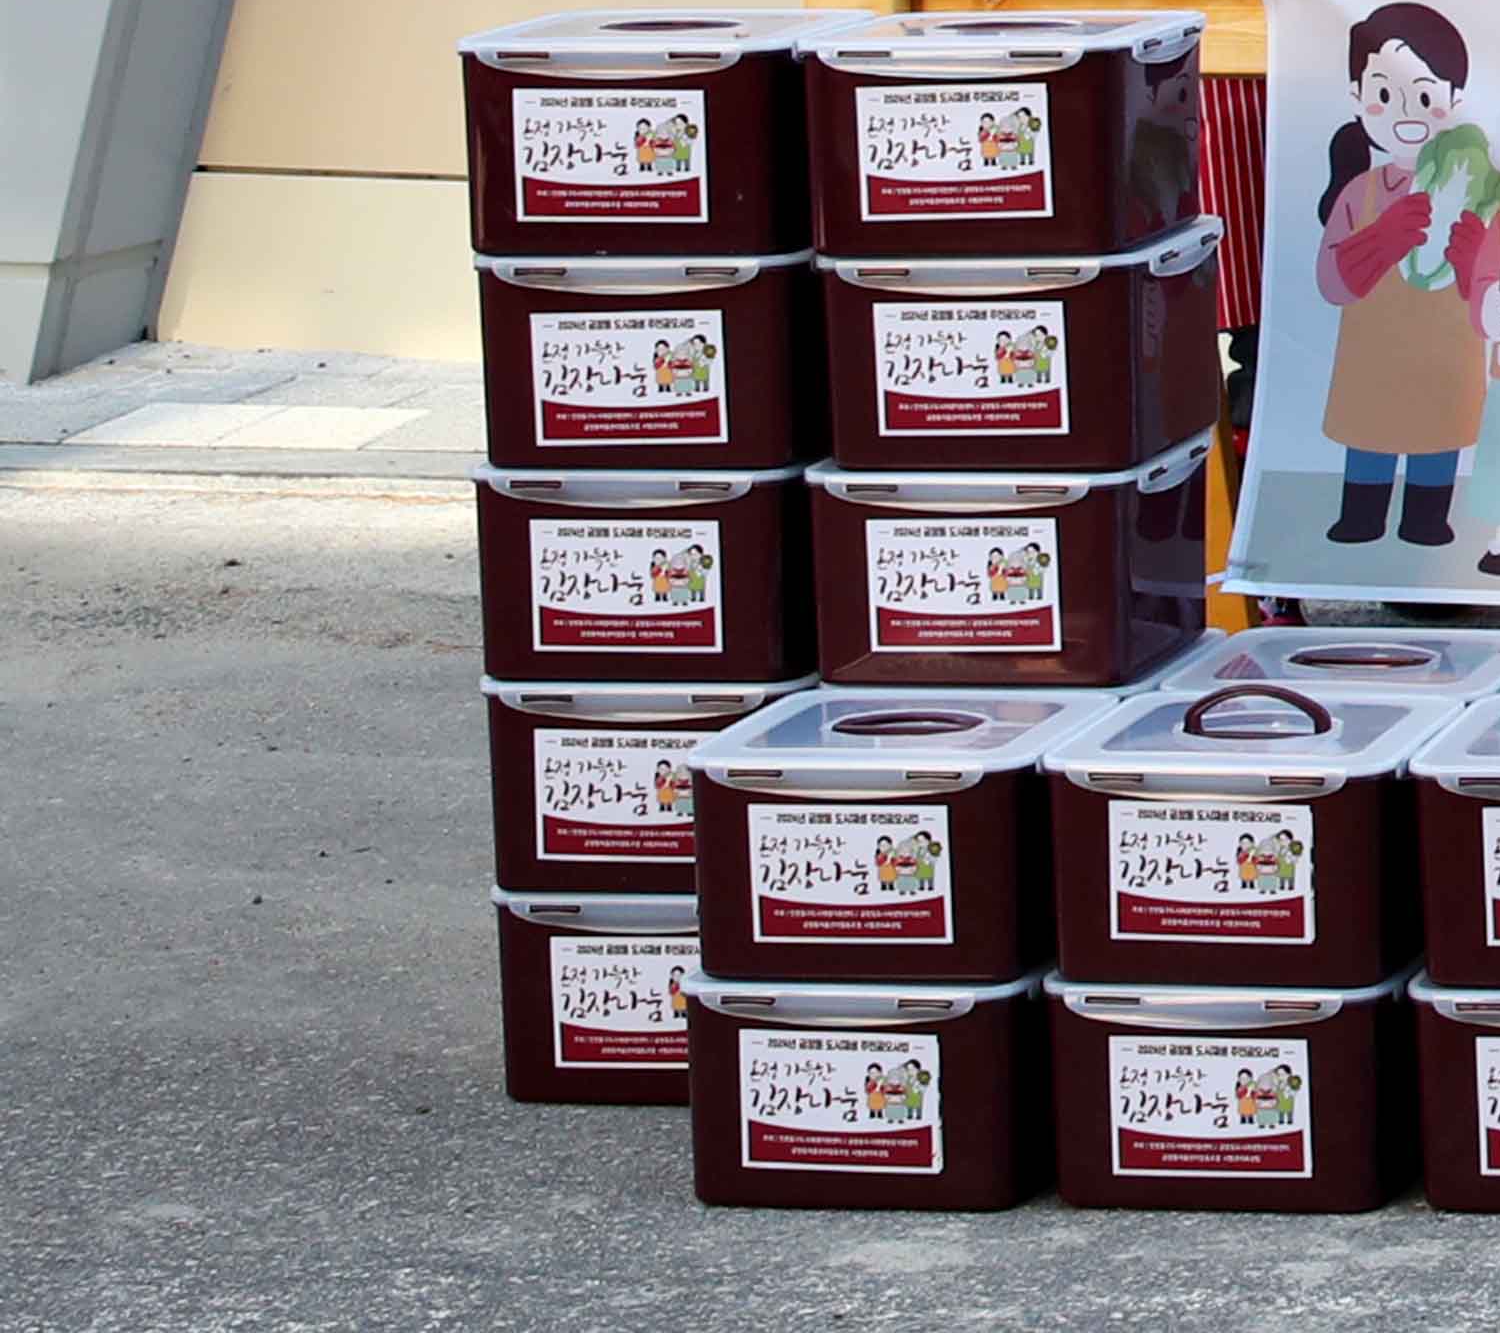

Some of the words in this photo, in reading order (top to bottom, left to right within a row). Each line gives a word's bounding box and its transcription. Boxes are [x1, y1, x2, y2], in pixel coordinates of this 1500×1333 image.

[523, 141, 630, 177] 김장나눔
[868, 137, 974, 175] 김장나눔
[542, 363, 649, 401] 김장나눔
[885, 354, 991, 391] 김장나눔
[540, 571, 645, 607] 김장나눔
[877, 570, 983, 607] 김장나눔
[544, 781, 649, 816] 김장나눔
[760, 858, 871, 896] 김장나눔
[1119, 855, 1231, 894] 김장나눔
[561, 988, 664, 1024] 김장나눔
[750, 1084, 860, 1123] 김장나눔
[1120, 1091, 1230, 1129] 김장나눔
